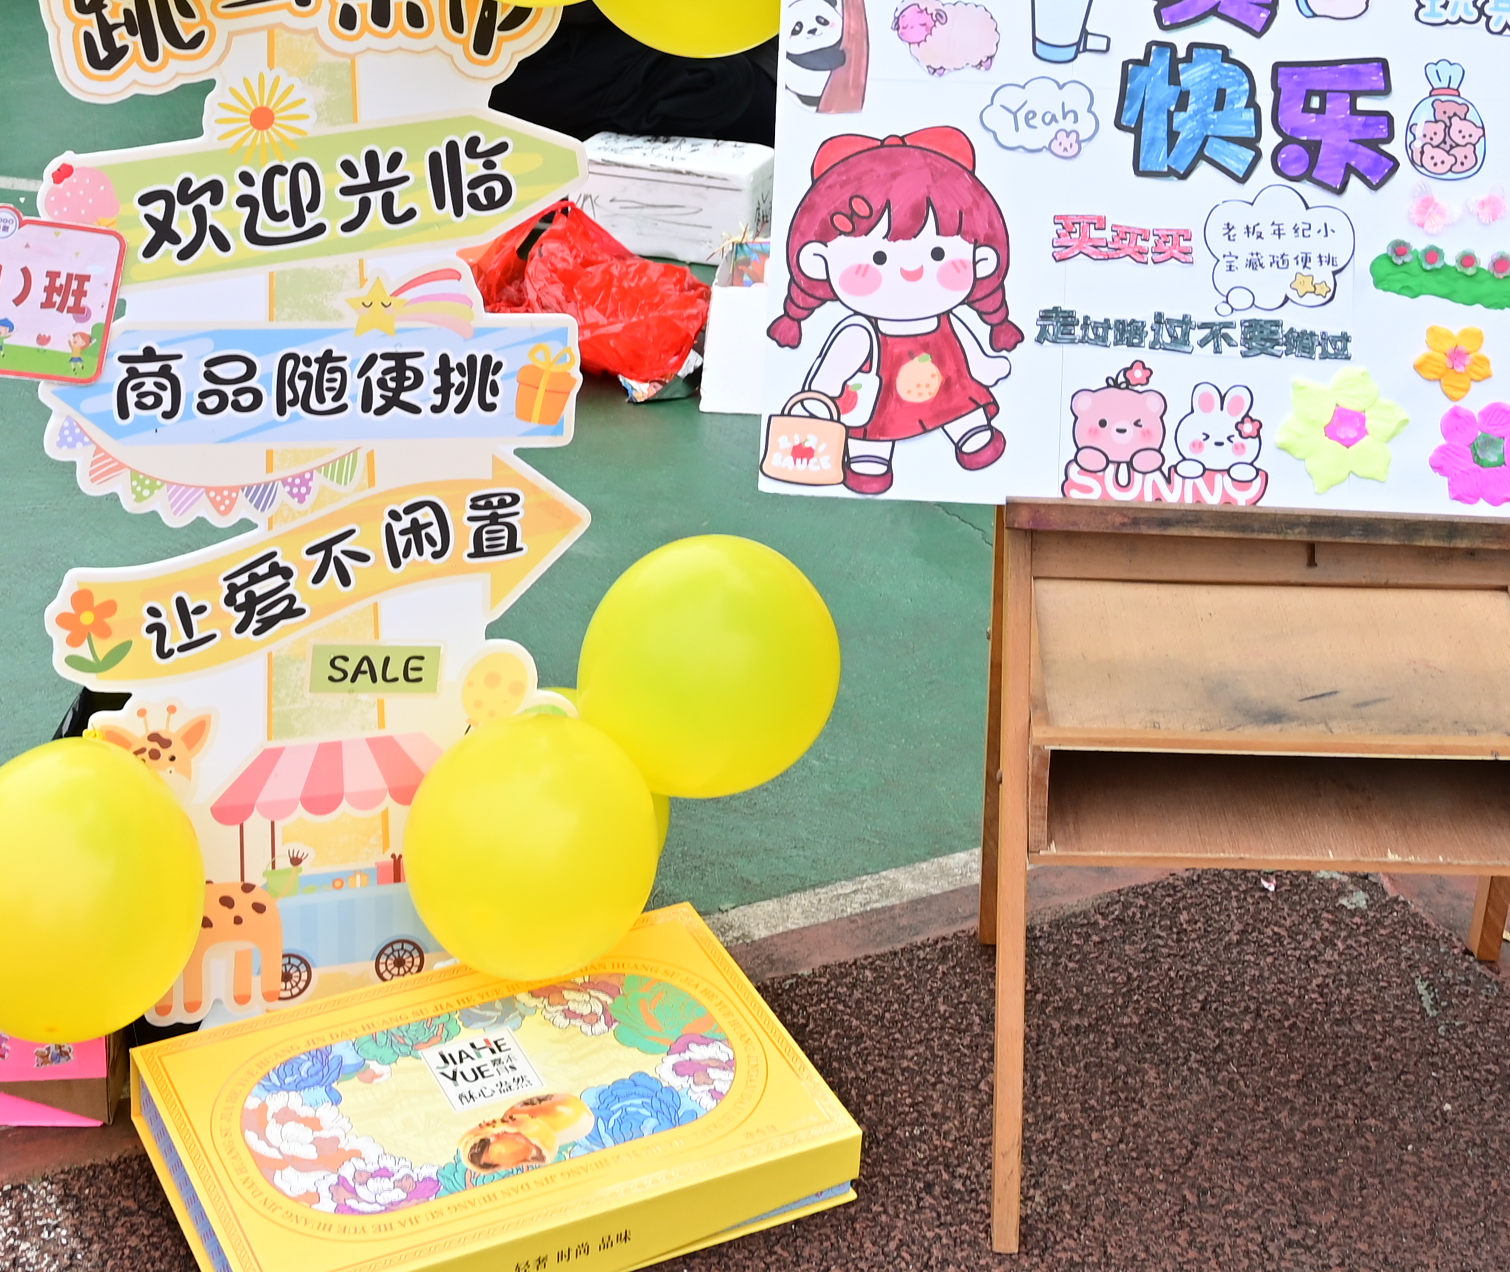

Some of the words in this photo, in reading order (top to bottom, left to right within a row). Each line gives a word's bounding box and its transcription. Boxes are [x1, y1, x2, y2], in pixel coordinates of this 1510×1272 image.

[997, 98, 1081, 131] Yeah
[1116, 42, 1400, 194] 快乐
[137, 134, 516, 262] 欢迎光临
[1052, 214, 1193, 265] 买买买
[1221, 221, 1337, 242] 老板年纪小
[1221, 252, 1339, 273] 宝藏随便挑
[1034, 305, 1352, 360] 走过路过不要错过
[115, 346, 505, 423] 商品随便挑
[1068, 462, 1263, 505] SUNNY
[146, 491, 529, 661] 让爱不闲置
[327, 655, 426, 684] SALE
[440, 1062, 494, 1087] YUE
